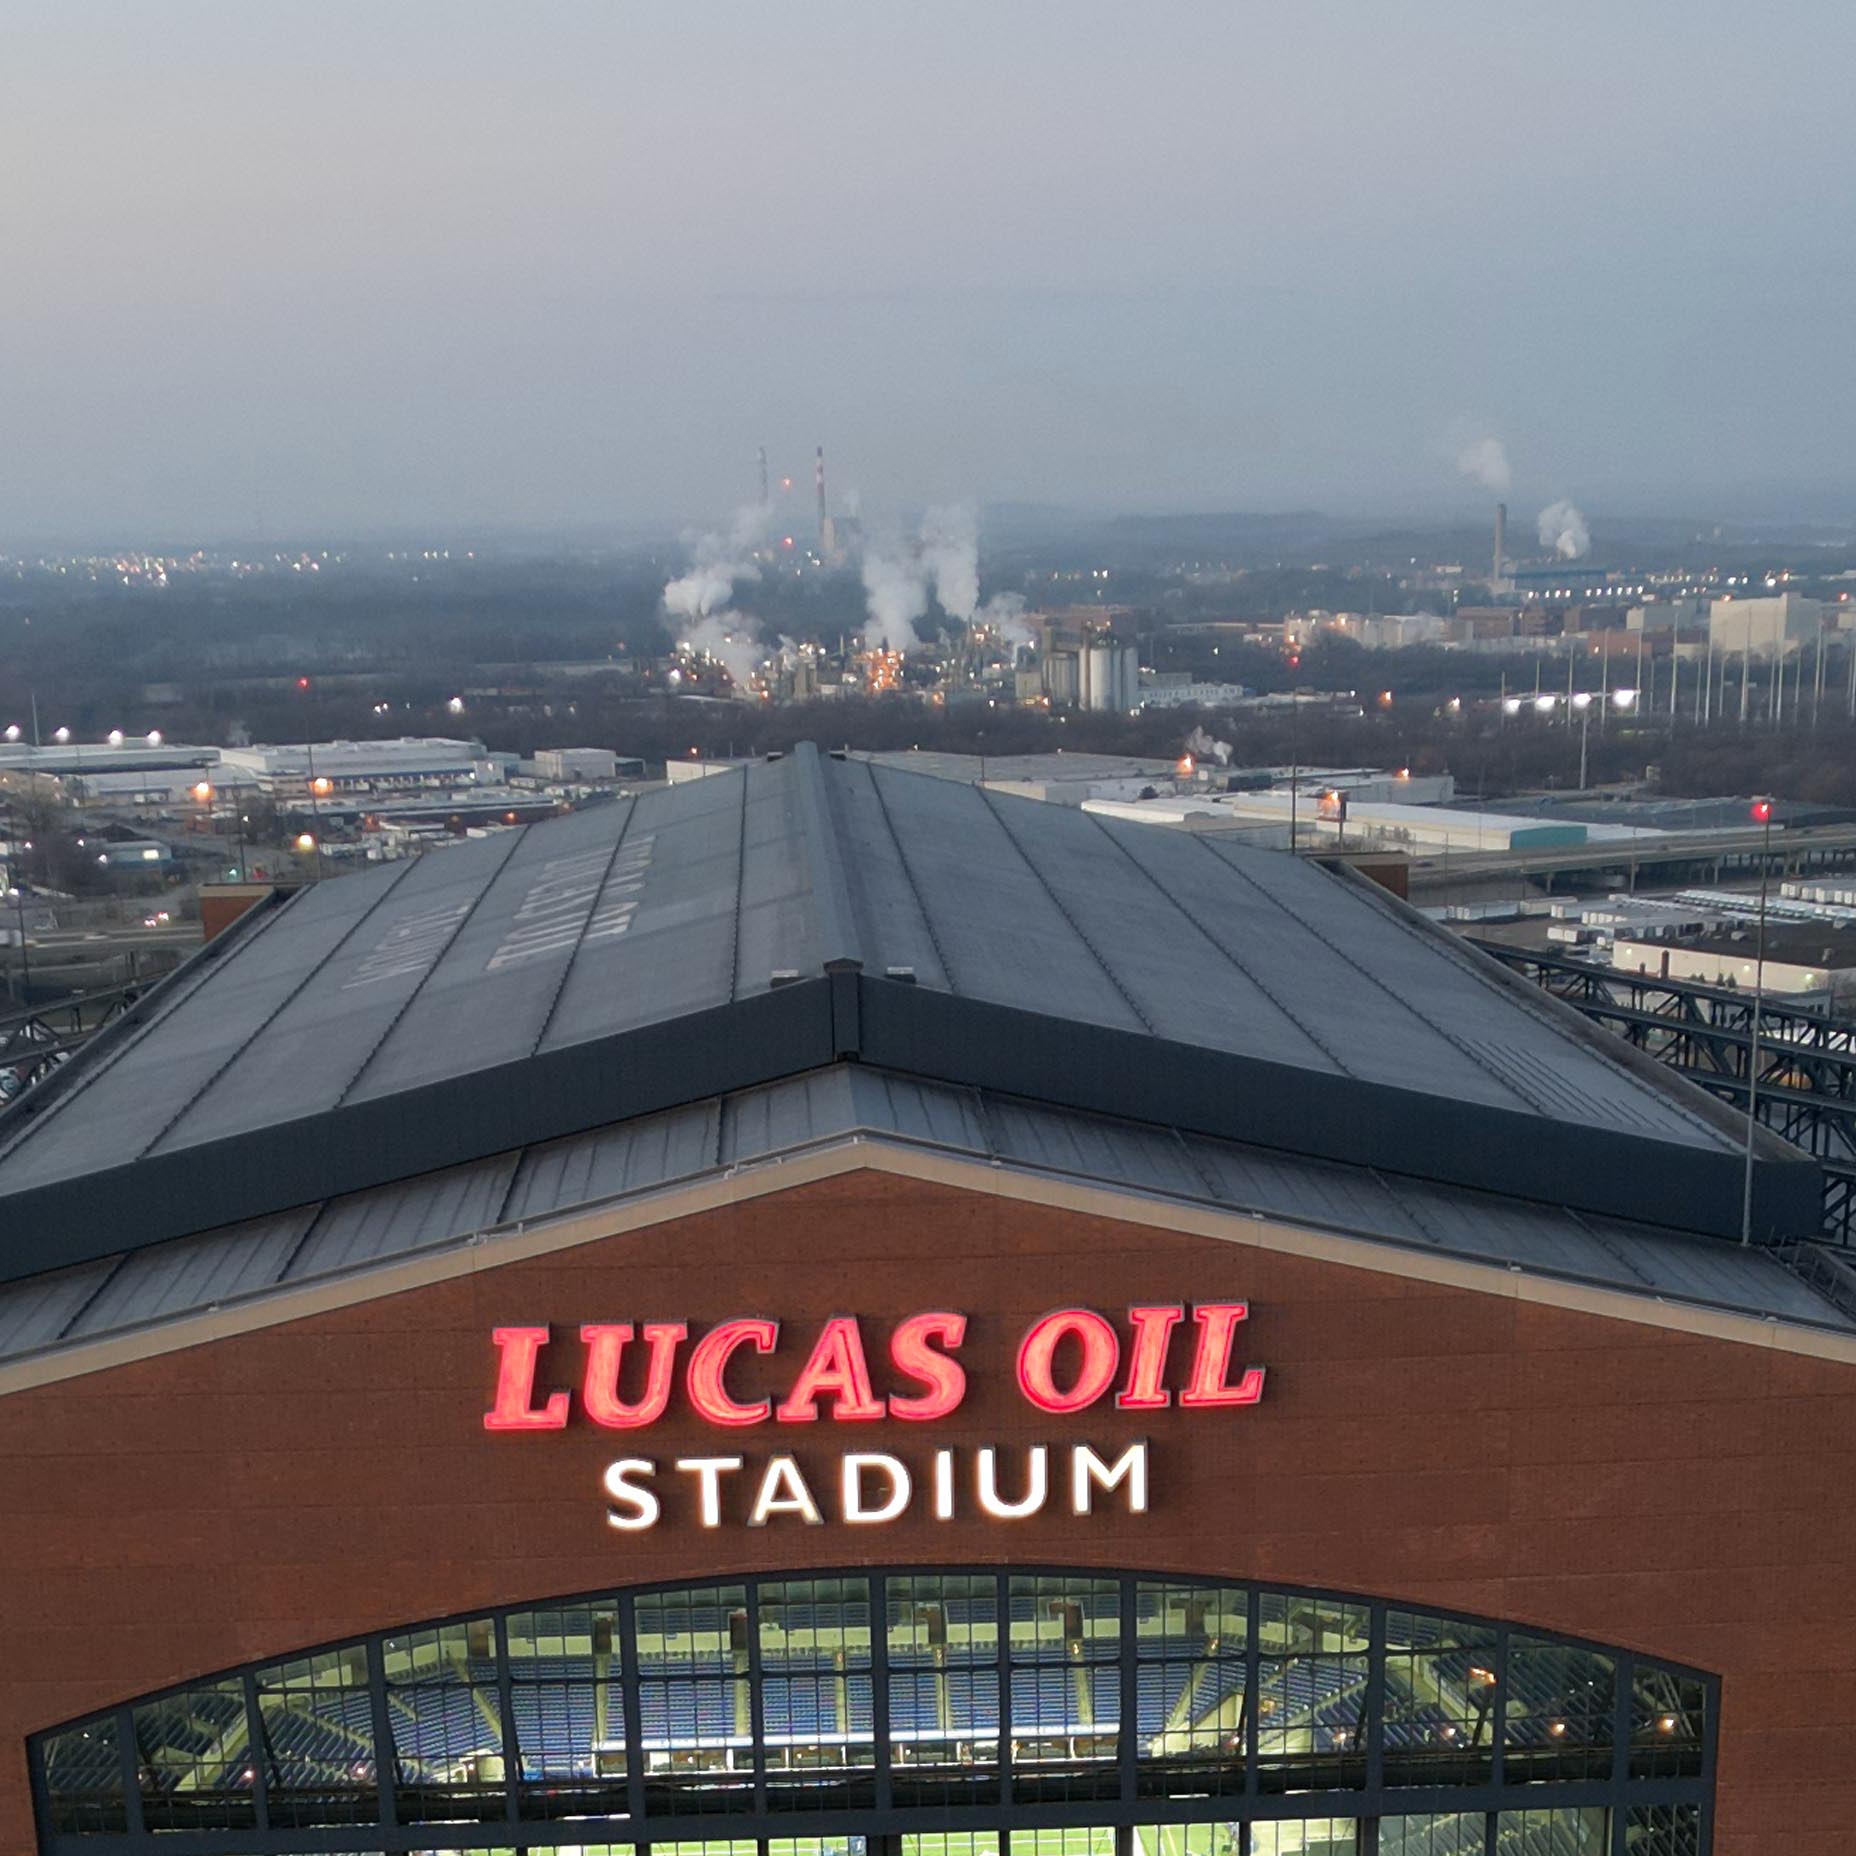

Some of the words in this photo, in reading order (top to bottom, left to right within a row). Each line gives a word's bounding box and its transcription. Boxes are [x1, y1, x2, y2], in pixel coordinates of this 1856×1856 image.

[484, 1310, 969, 1430] LUCAS
[1016, 1301, 1265, 1413] OIL
[603, 1438, 1149, 1530] STADIUM
